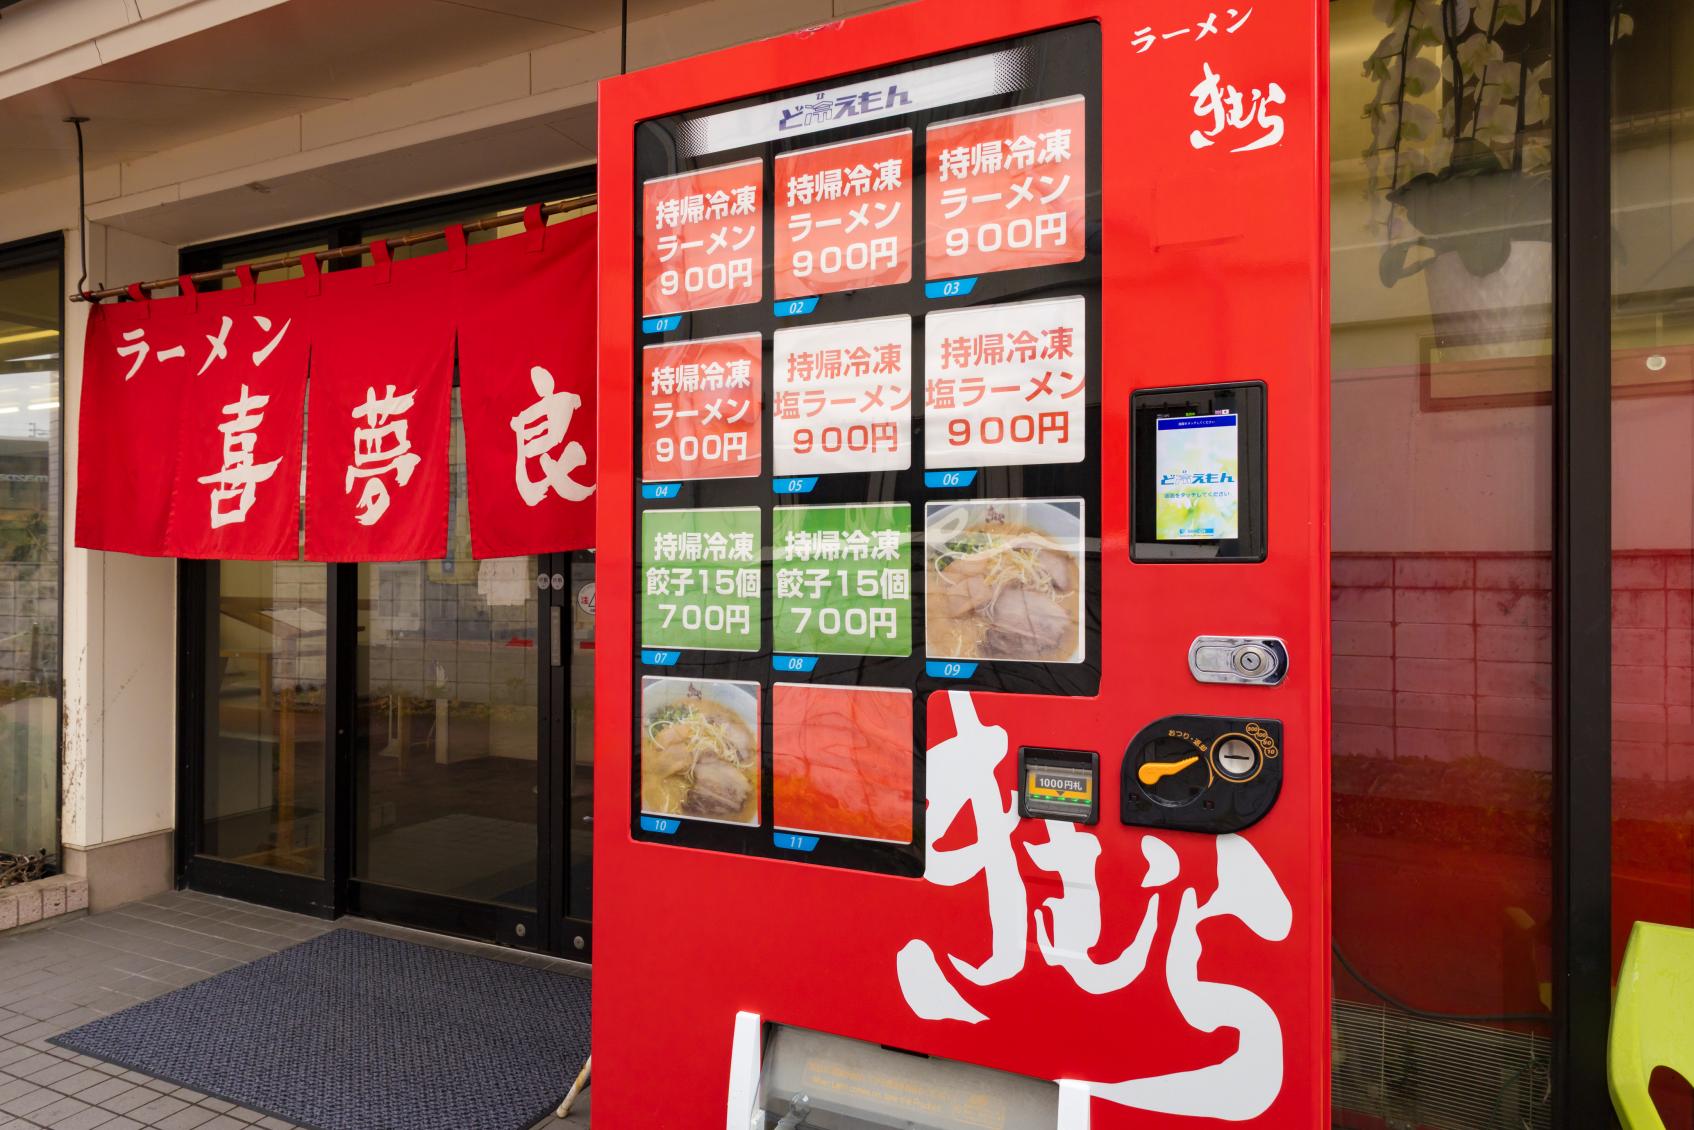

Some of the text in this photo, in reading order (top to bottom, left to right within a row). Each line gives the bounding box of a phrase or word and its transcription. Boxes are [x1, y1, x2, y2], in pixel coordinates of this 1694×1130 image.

[1131, 7, 1253, 53] ラーメン
[938, 128, 1071, 182] 持帰冷凍
[787, 159, 903, 208] 持帰冷凍
[941, 175, 1070, 220] ラーメン
[656, 186, 757, 230] 持帰冷凍
[788, 201, 901, 243] ラーメン
[656, 225, 755, 263] ラーメン
[945, 212, 1067, 257] 900円
[792, 237, 899, 278] 900円
[661, 257, 752, 296] 900円
[943, 282, 960, 296] 03
[789, 301, 803, 314] 02
[656, 320, 669, 331] 01
[117, 315, 291, 381] ラーメン
[787, 343, 901, 383] 持帰冷凍
[940, 326, 1074, 370] 持帰冷凍
[651, 359, 751, 396] 持帰冷凍
[925, 371, 1086, 410] 塩ラーメン
[652, 398, 750, 429] ラーメン
[774, 384, 912, 420] 塩ラーメン
[793, 421, 898, 453] 900円
[948, 410, 1069, 446] 900円
[656, 431, 748, 463] 900円
[655, 486, 668, 497] 04
[788, 479, 802, 491] 05
[943, 472, 959, 486] 06
[654, 532, 754, 562] 持帰冷凍
[785, 529, 900, 562] 持帰冷凍
[646, 568, 761, 598] 餃子15個
[777, 568, 909, 600] 餃子15個
[659, 604, 750, 635] 700円
[791, 607, 897, 638] 700円
[654, 652, 668, 663] 07
[788, 658, 802, 670] 08
[944, 664, 961, 677] 09
[1040, 778, 1083, 791] 1000円札
[655, 820, 667, 831] 10
[790, 837, 803, 848] 11
